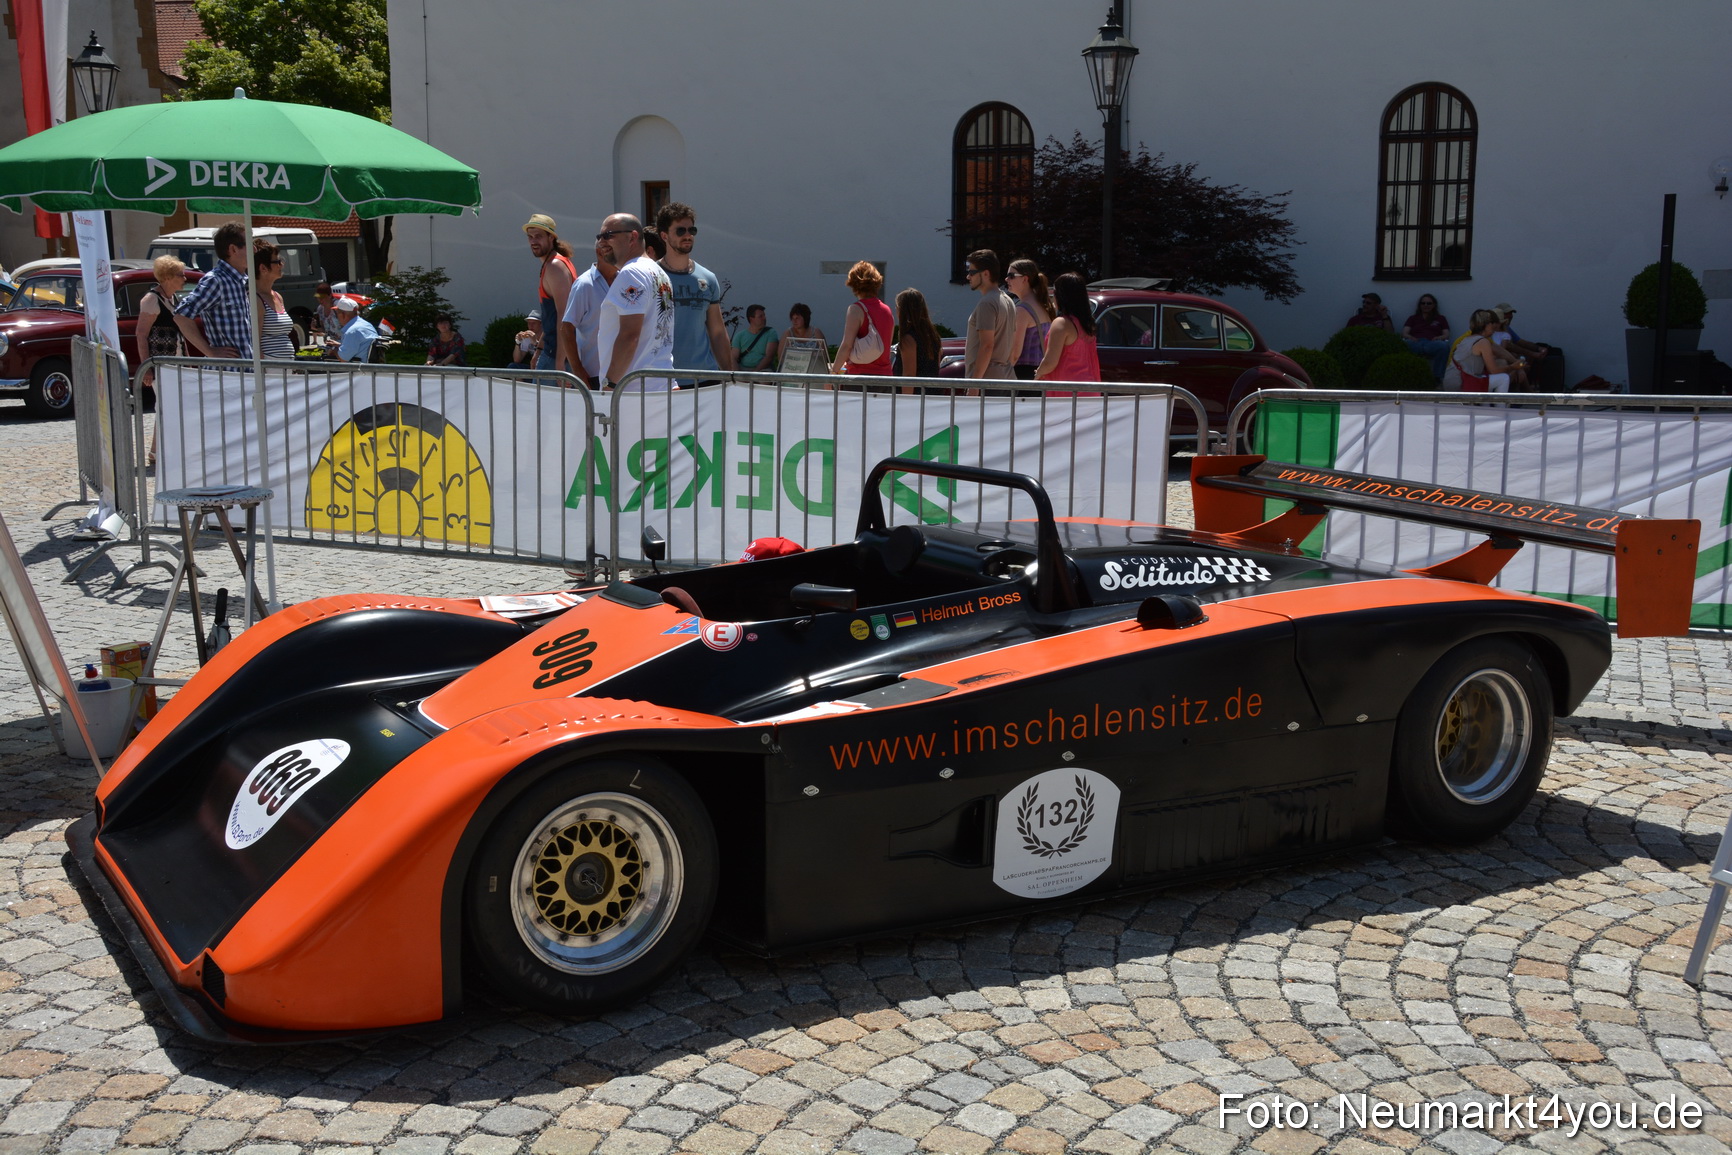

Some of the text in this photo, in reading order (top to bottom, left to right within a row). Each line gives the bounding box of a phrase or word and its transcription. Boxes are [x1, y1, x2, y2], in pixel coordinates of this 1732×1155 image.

[189, 160, 291, 190] DEKRA
[1099, 560, 1217, 591] Solitude
[1121, 556, 1193, 566] SCUDERIA
[921, 591, 1022, 623] Helmut Bross
[713, 624, 729, 642] E
[829, 687, 1263, 771] www.imschalensitz.de
[1034, 798, 1079, 830] 132
[1042, 875, 1083, 888] OPPENHEIM
